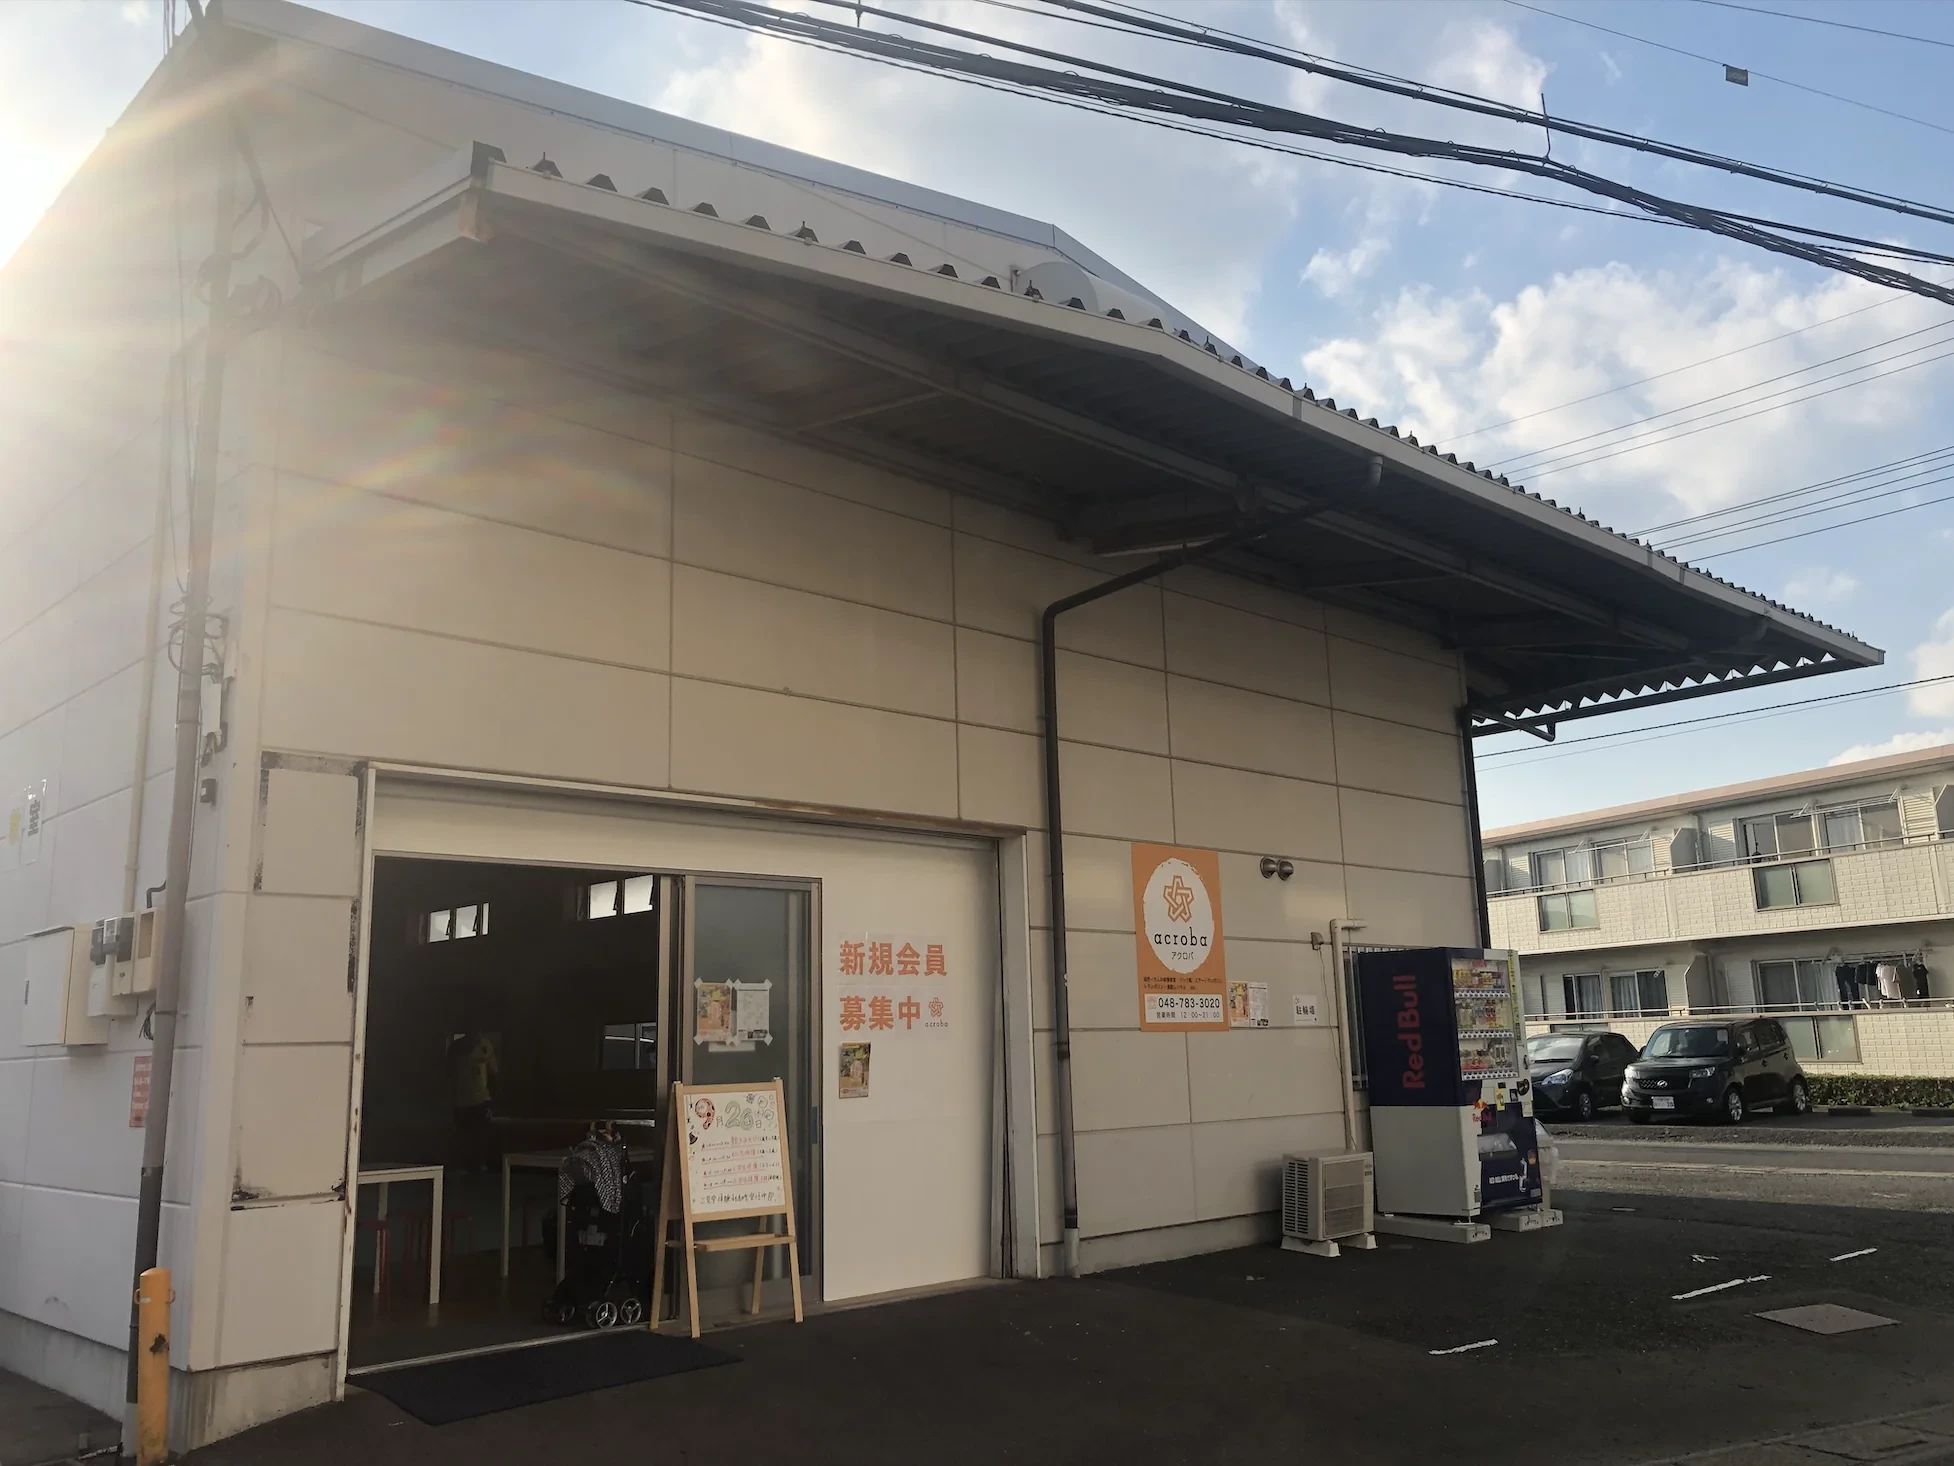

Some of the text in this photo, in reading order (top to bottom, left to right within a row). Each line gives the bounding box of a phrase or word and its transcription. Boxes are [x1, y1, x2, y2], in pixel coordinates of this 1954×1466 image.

[1154, 927, 1207, 946] acroba
[839, 940, 948, 977] 新規会員
[1171, 951, 1195, 960] アクロバ
[1158, 997, 1220, 1008] 048-783-3020
[839, 995, 922, 1031] 募集中
[1156, 1011, 1176, 1019] 営業時間
[925, 1019, 948, 1028] acroba
[1392, 975, 1426, 1088] Red Bull
